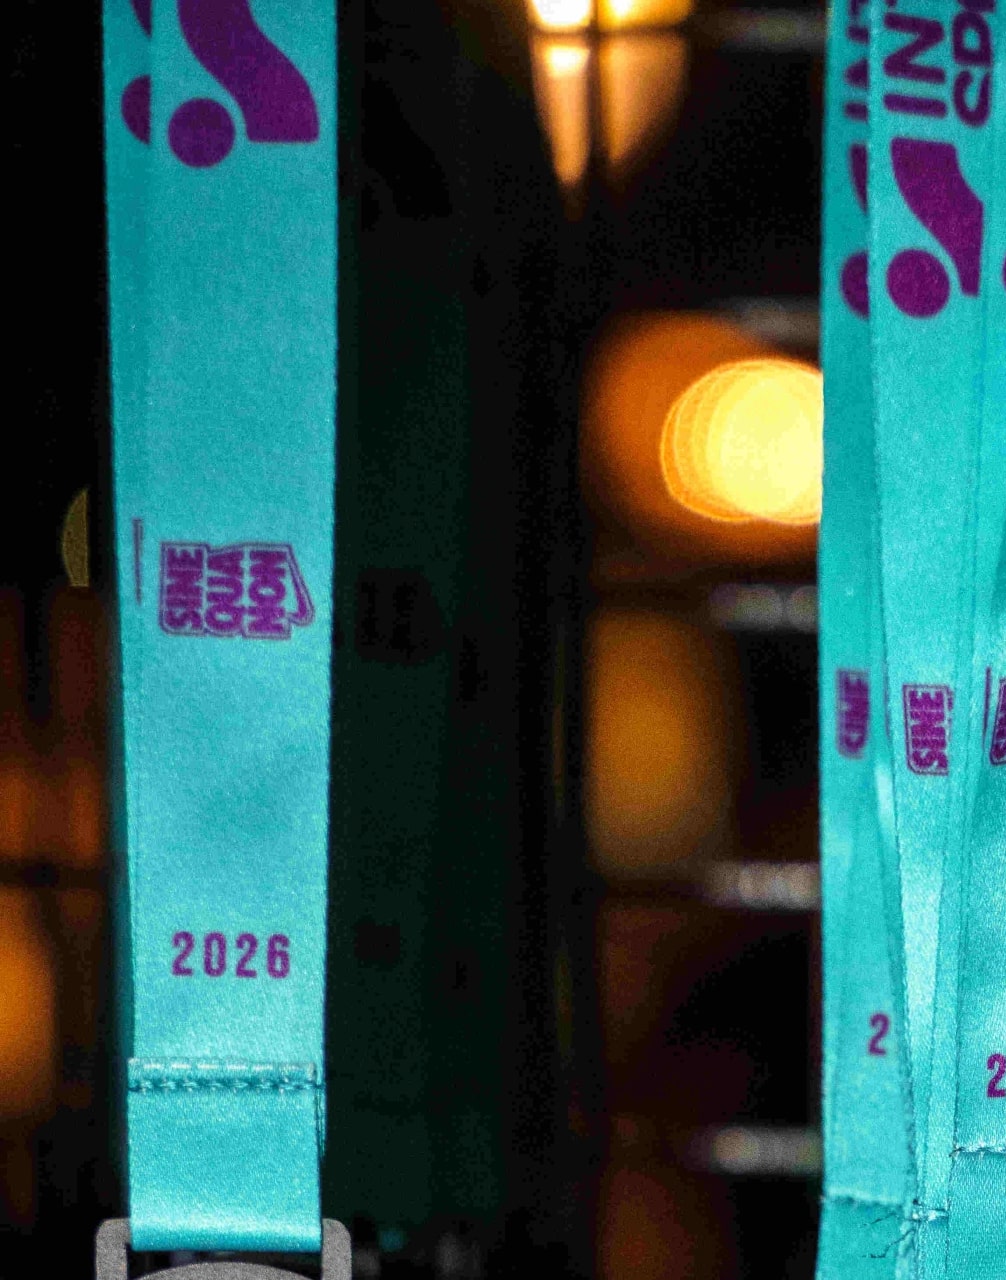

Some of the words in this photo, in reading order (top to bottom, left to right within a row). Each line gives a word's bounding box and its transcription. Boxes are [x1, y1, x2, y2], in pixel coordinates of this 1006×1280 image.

[165, 548, 204, 630] SINE
[204, 551, 245, 632] QUA
[248, 550, 287, 634] NON
[908, 690, 949, 769] SINE
[171, 930, 290, 979] 2026
